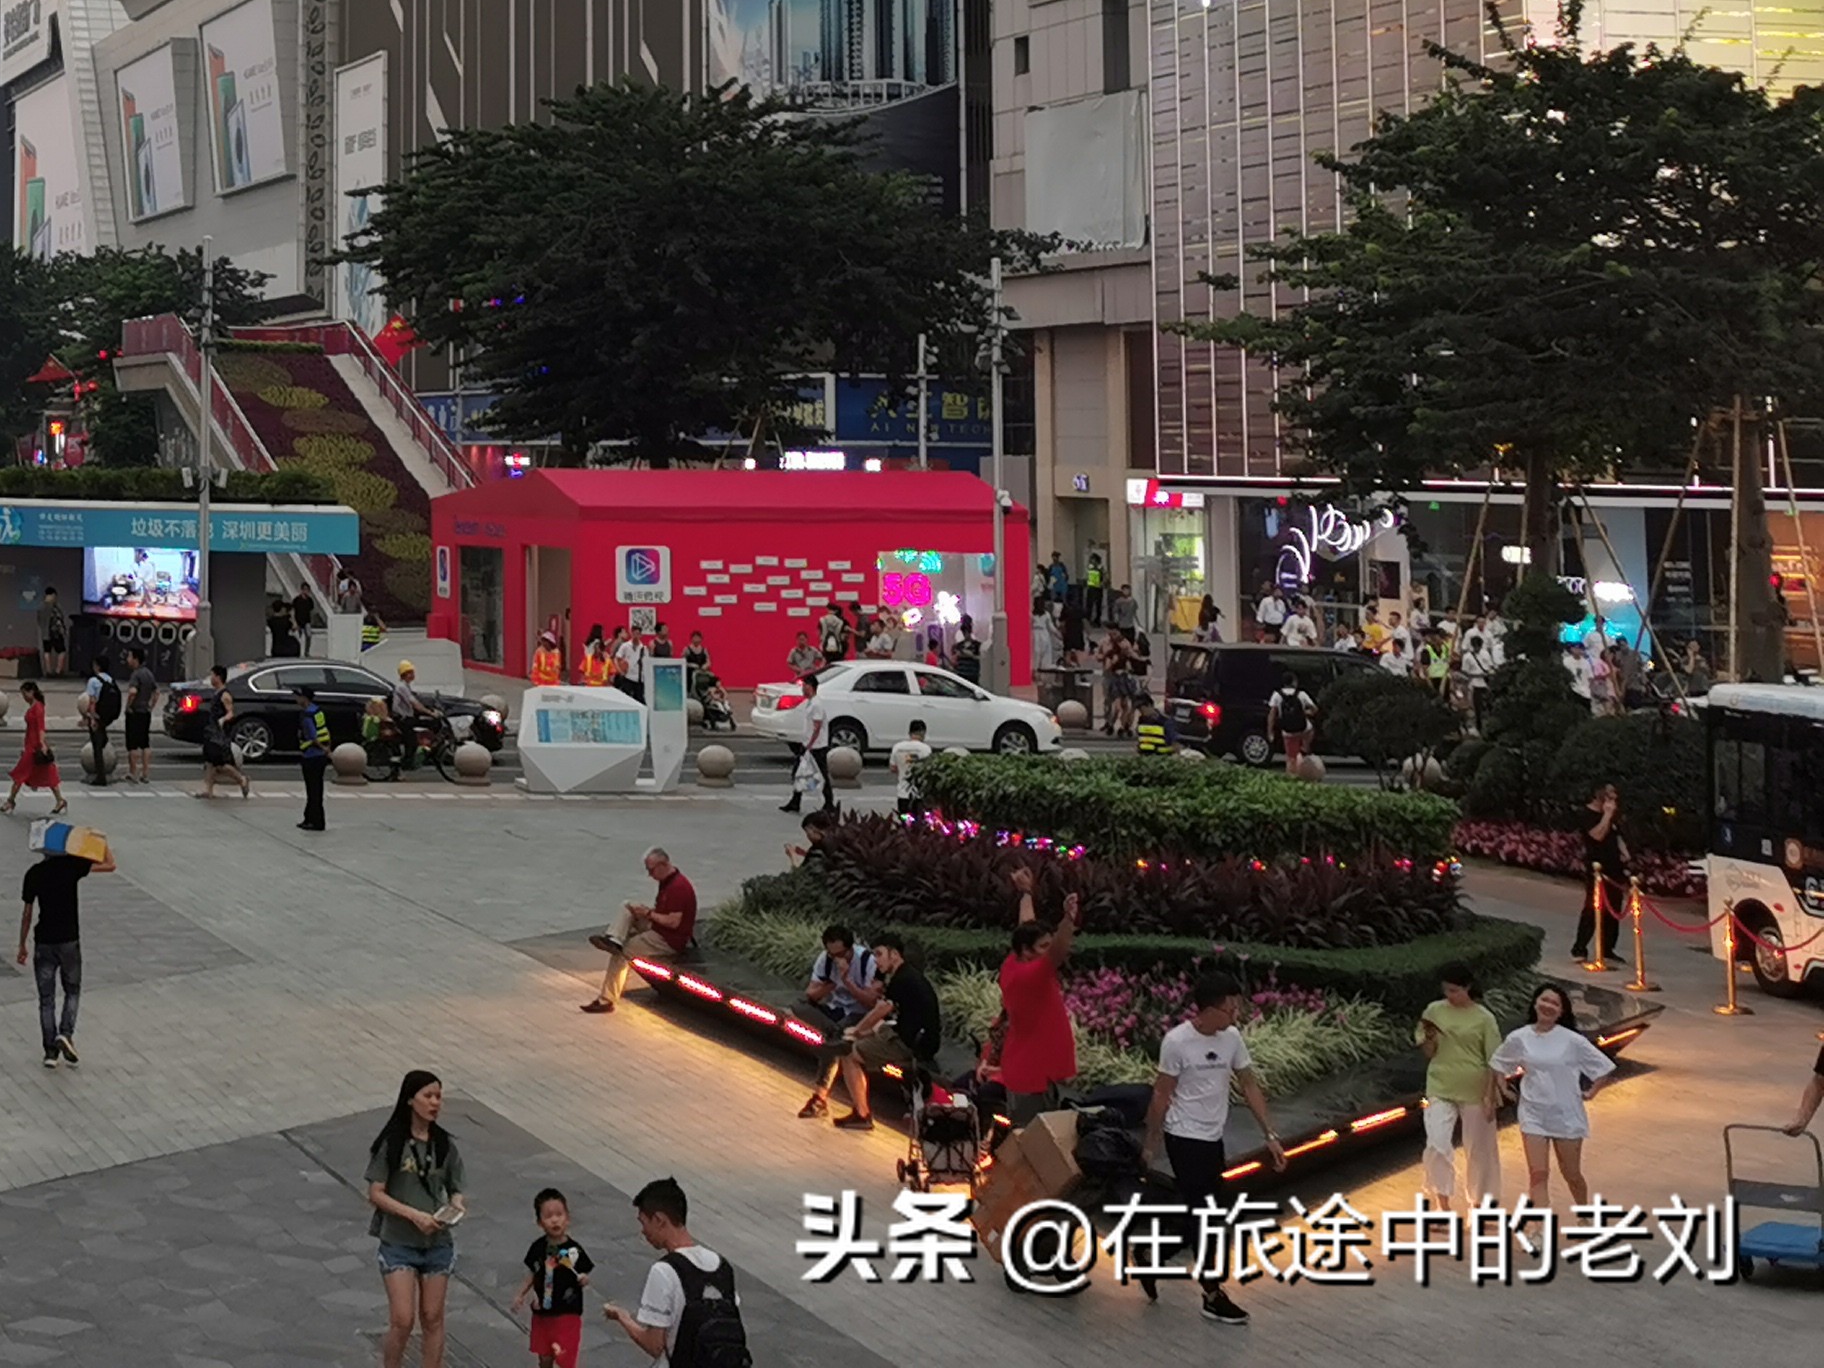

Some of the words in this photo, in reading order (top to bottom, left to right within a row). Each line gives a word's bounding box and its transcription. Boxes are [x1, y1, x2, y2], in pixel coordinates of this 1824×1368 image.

[222, 519, 308, 543] 深圳更美丽
[882, 572, 932, 608] 5G
